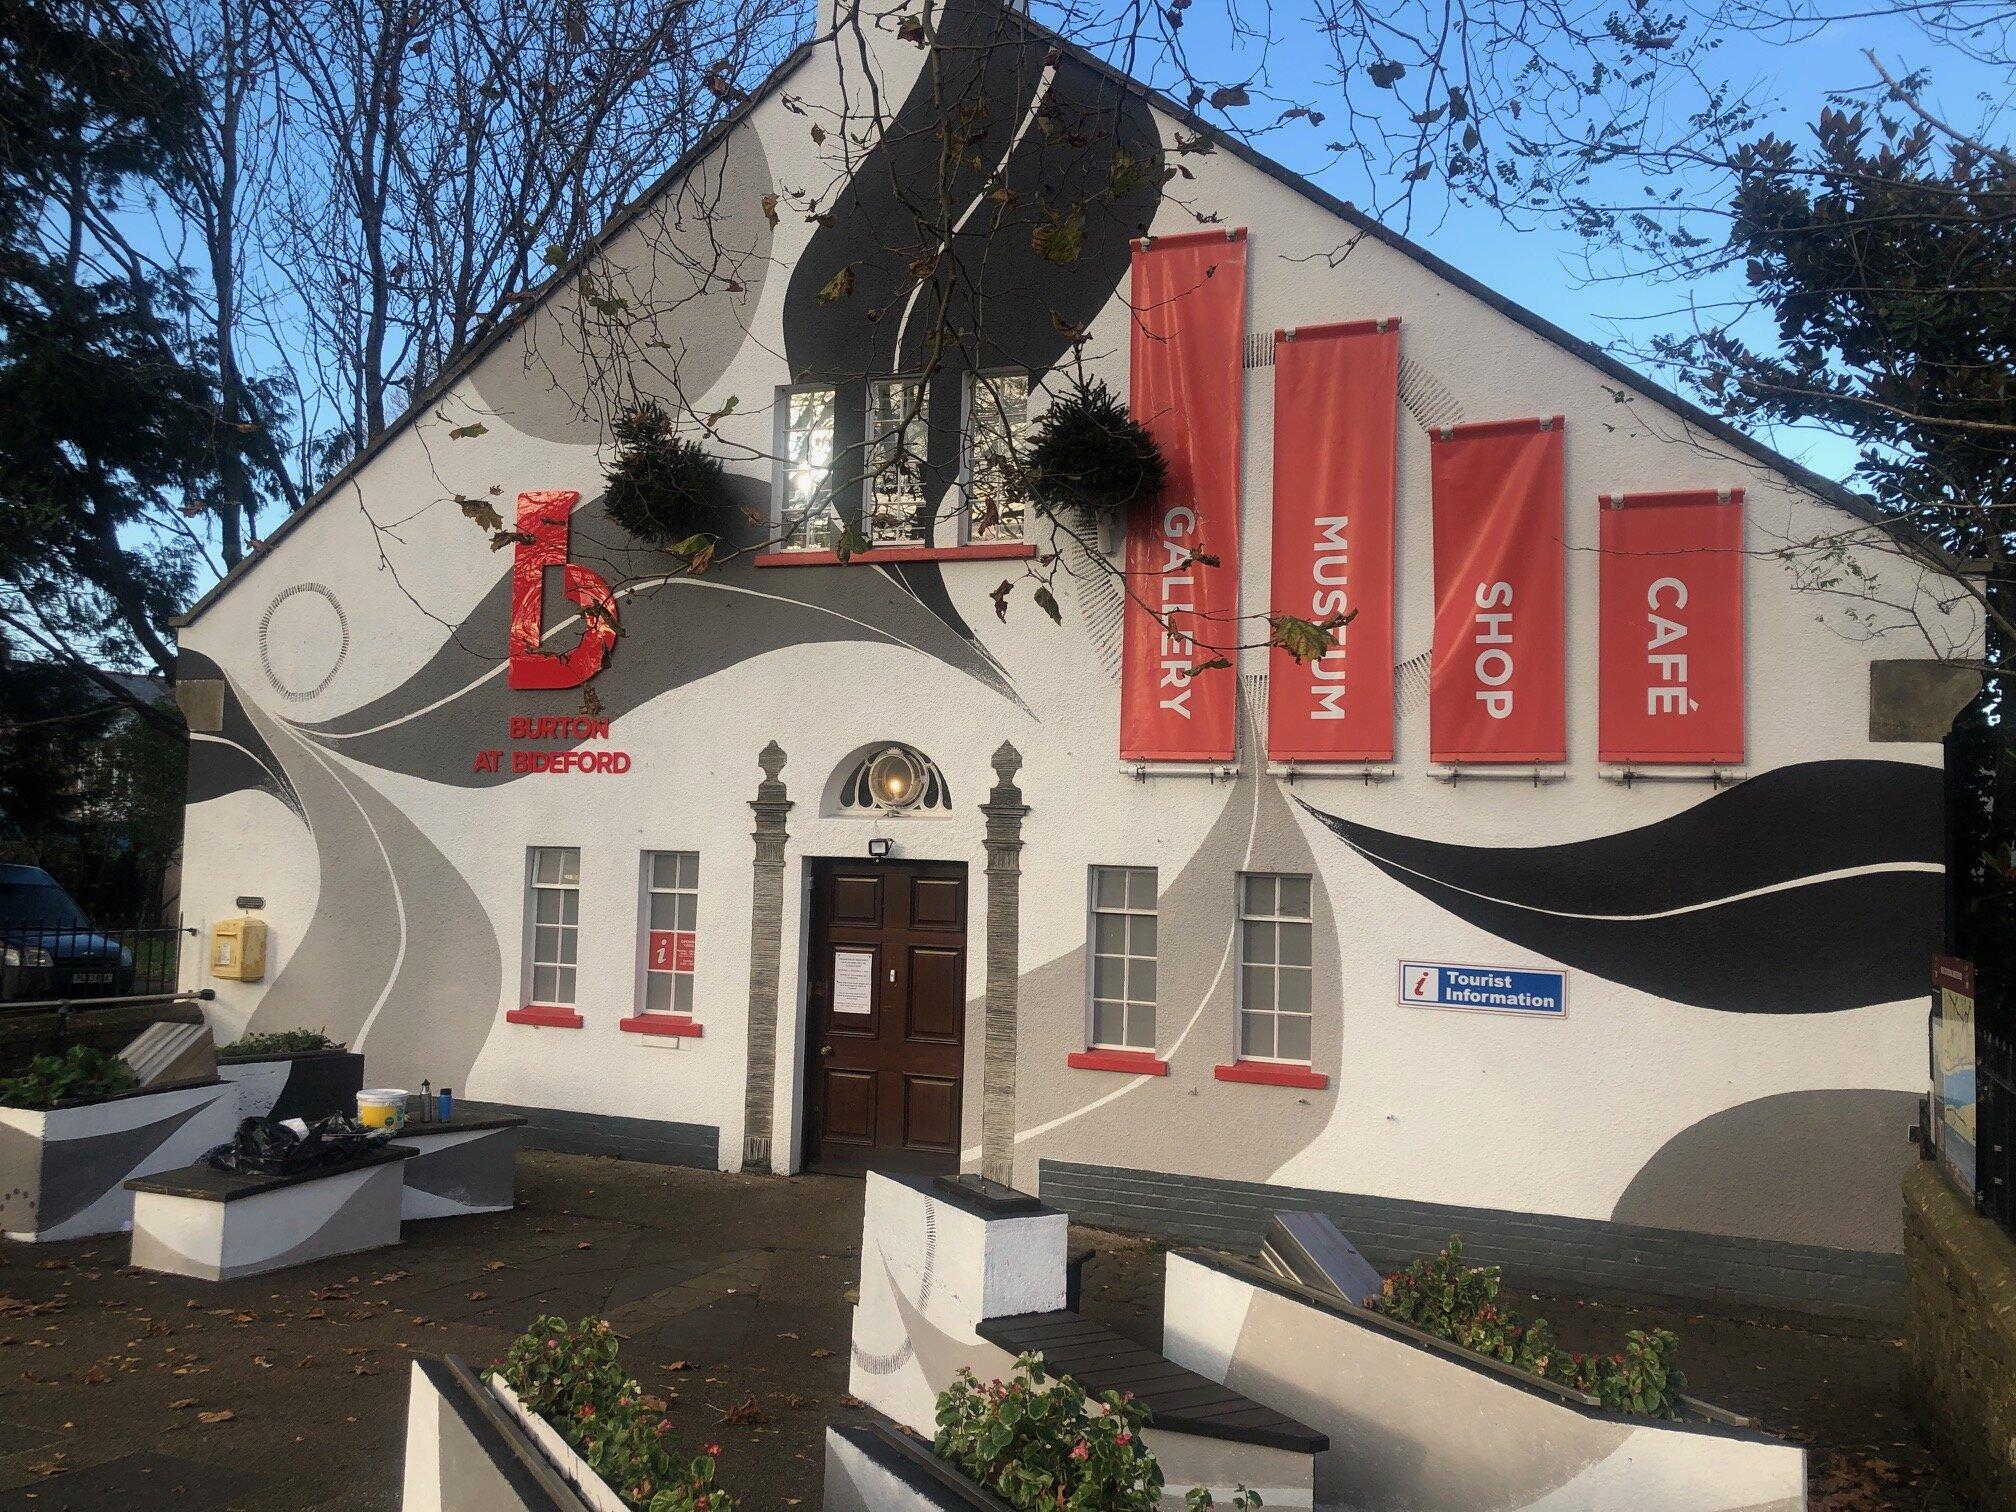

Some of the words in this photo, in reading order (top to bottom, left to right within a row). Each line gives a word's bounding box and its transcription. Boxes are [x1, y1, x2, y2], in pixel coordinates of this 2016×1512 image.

[1159, 505, 1197, 720] GALLERY
[1475, 581, 1514, 719] SHOP
[1647, 576, 1700, 716] CAFÉ
[509, 716, 610, 740] BURTON
[472, 750, 504, 773] AT
[511, 751, 632, 774] BIDEFORD
[1446, 970, 1512, 989] Tourist
[1445, 987, 1555, 1008] Information
